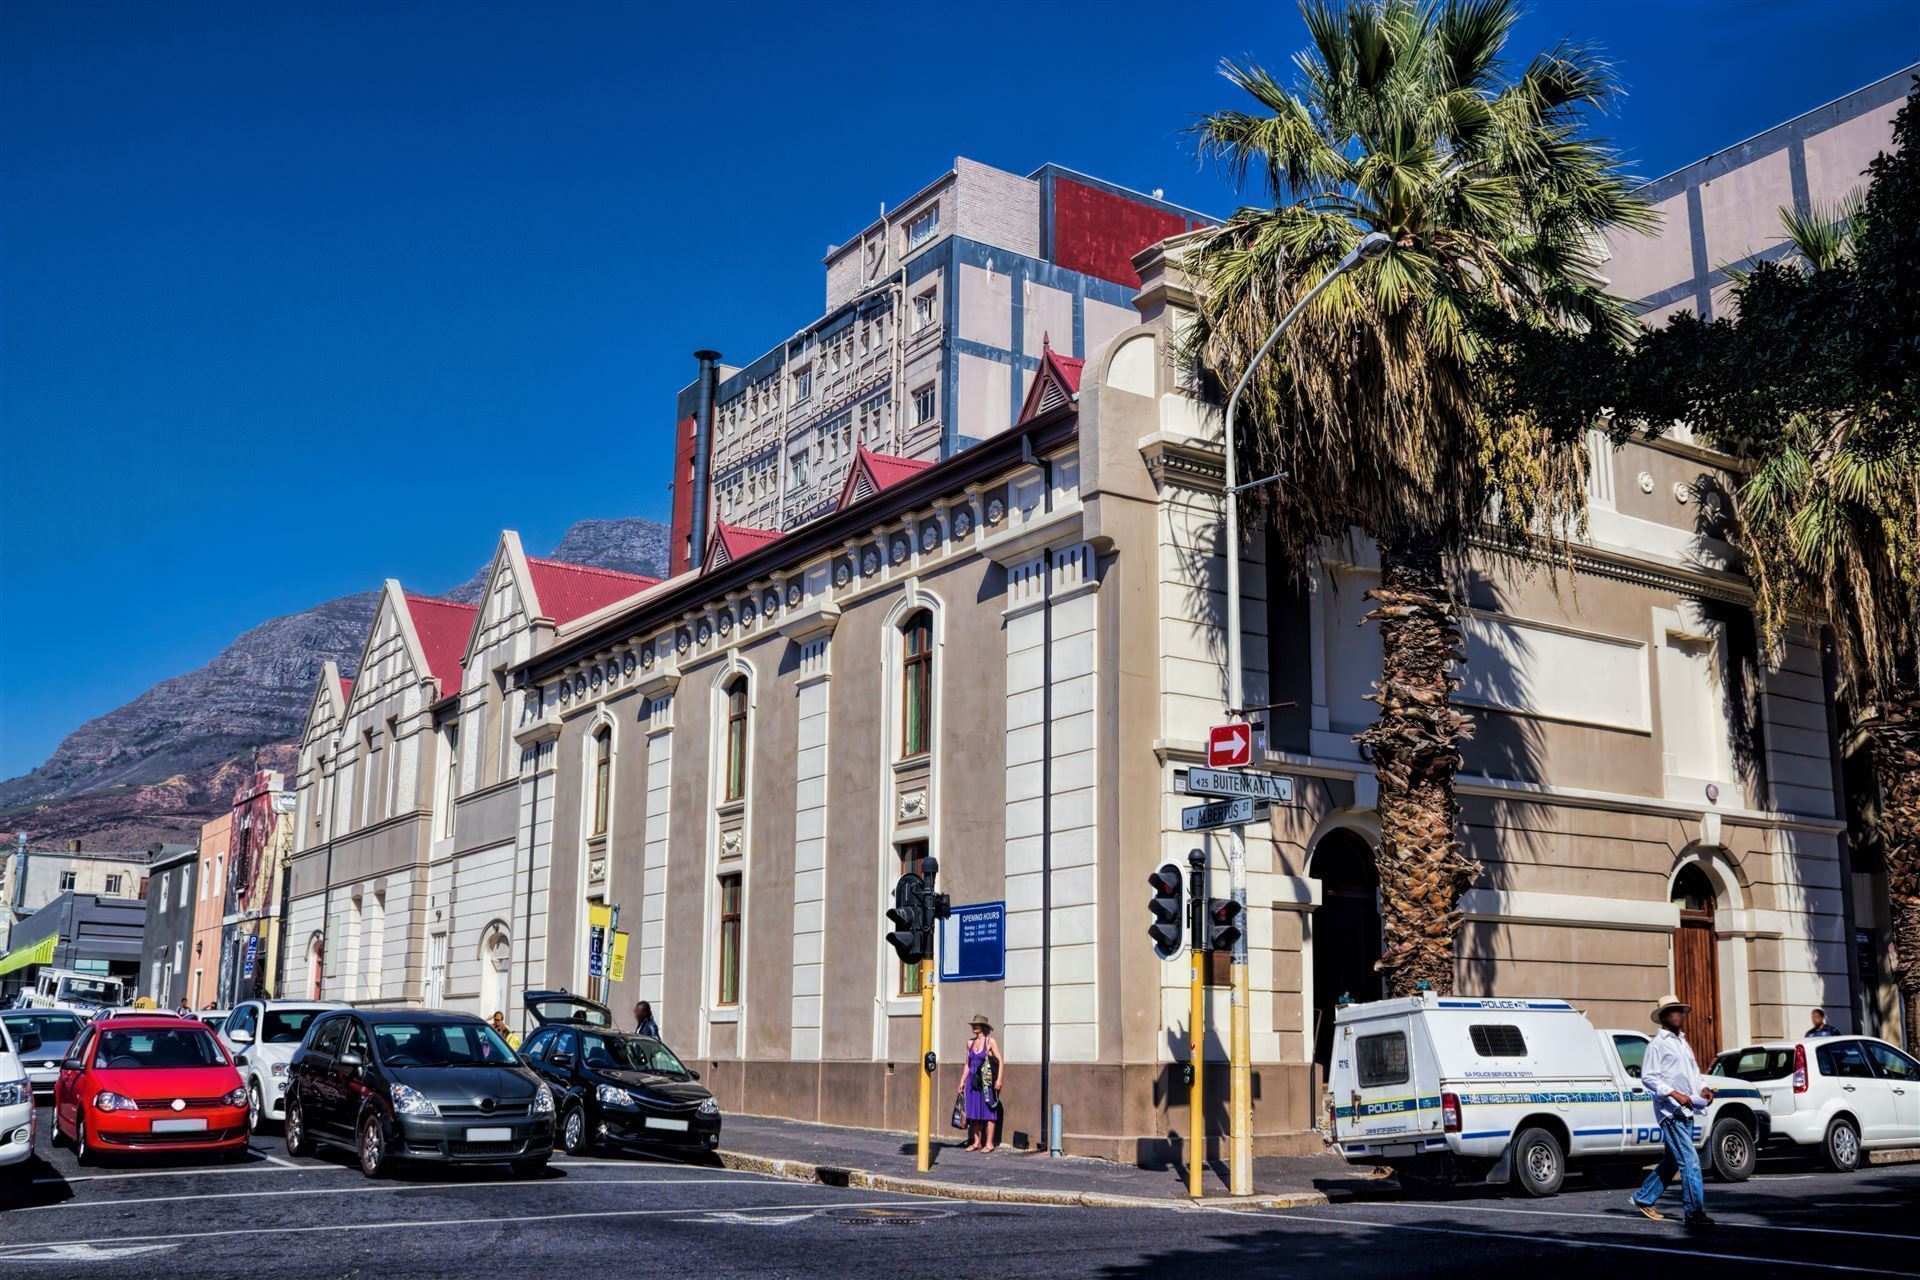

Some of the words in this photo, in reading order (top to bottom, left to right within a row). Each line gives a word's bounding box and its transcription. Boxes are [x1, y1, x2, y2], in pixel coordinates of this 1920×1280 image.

[1201, 778, 1209, 788] 25
[1213, 775, 1271, 797] BUITENKANT
[1189, 816, 1194, 826] 2
[1197, 804, 1239, 825] ALBERTUS
[1242, 801, 1249, 812] ST
[962, 913, 983, 923] OPENING
[983, 911, 1000, 921] HOURS
[593, 938, 600, 953] R
[1480, 1000, 1515, 1009] POLICE
[1367, 1101, 1405, 1115] POLICE
[1636, 1127, 1702, 1144] POE
